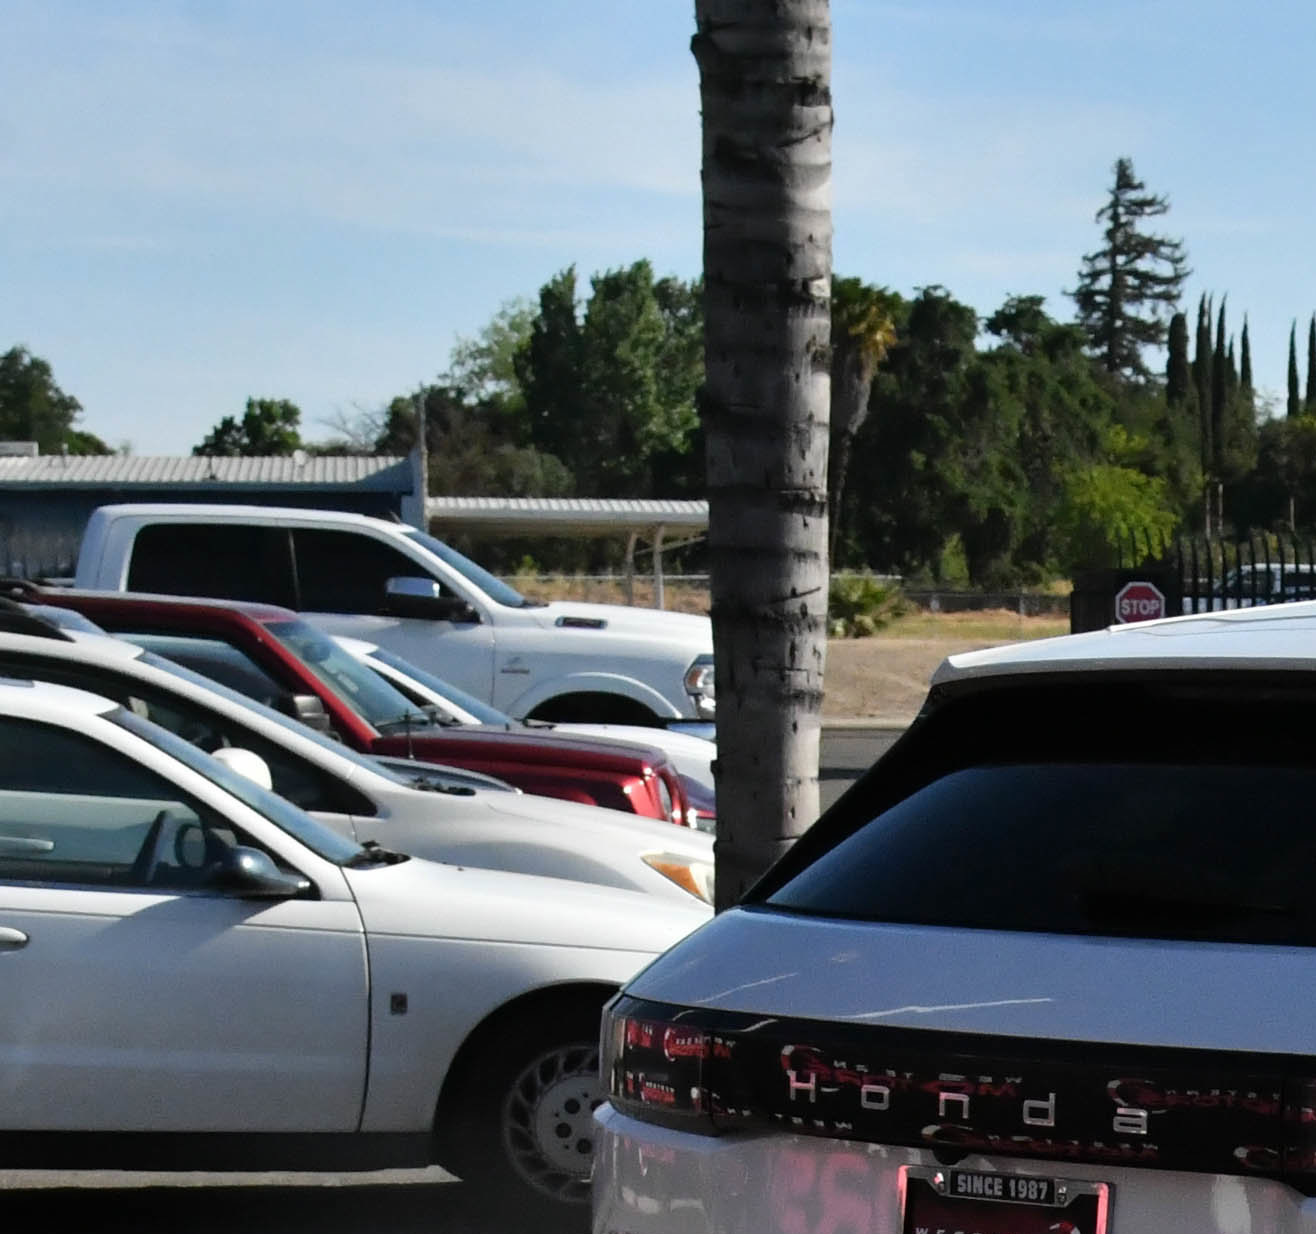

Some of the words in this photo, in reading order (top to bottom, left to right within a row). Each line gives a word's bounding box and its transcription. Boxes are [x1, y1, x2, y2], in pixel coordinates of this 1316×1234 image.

[1120, 598, 1161, 616] STOP
[957, 1174, 1003, 1197] SINCE
[1008, 1180, 1049, 1200] 1987
